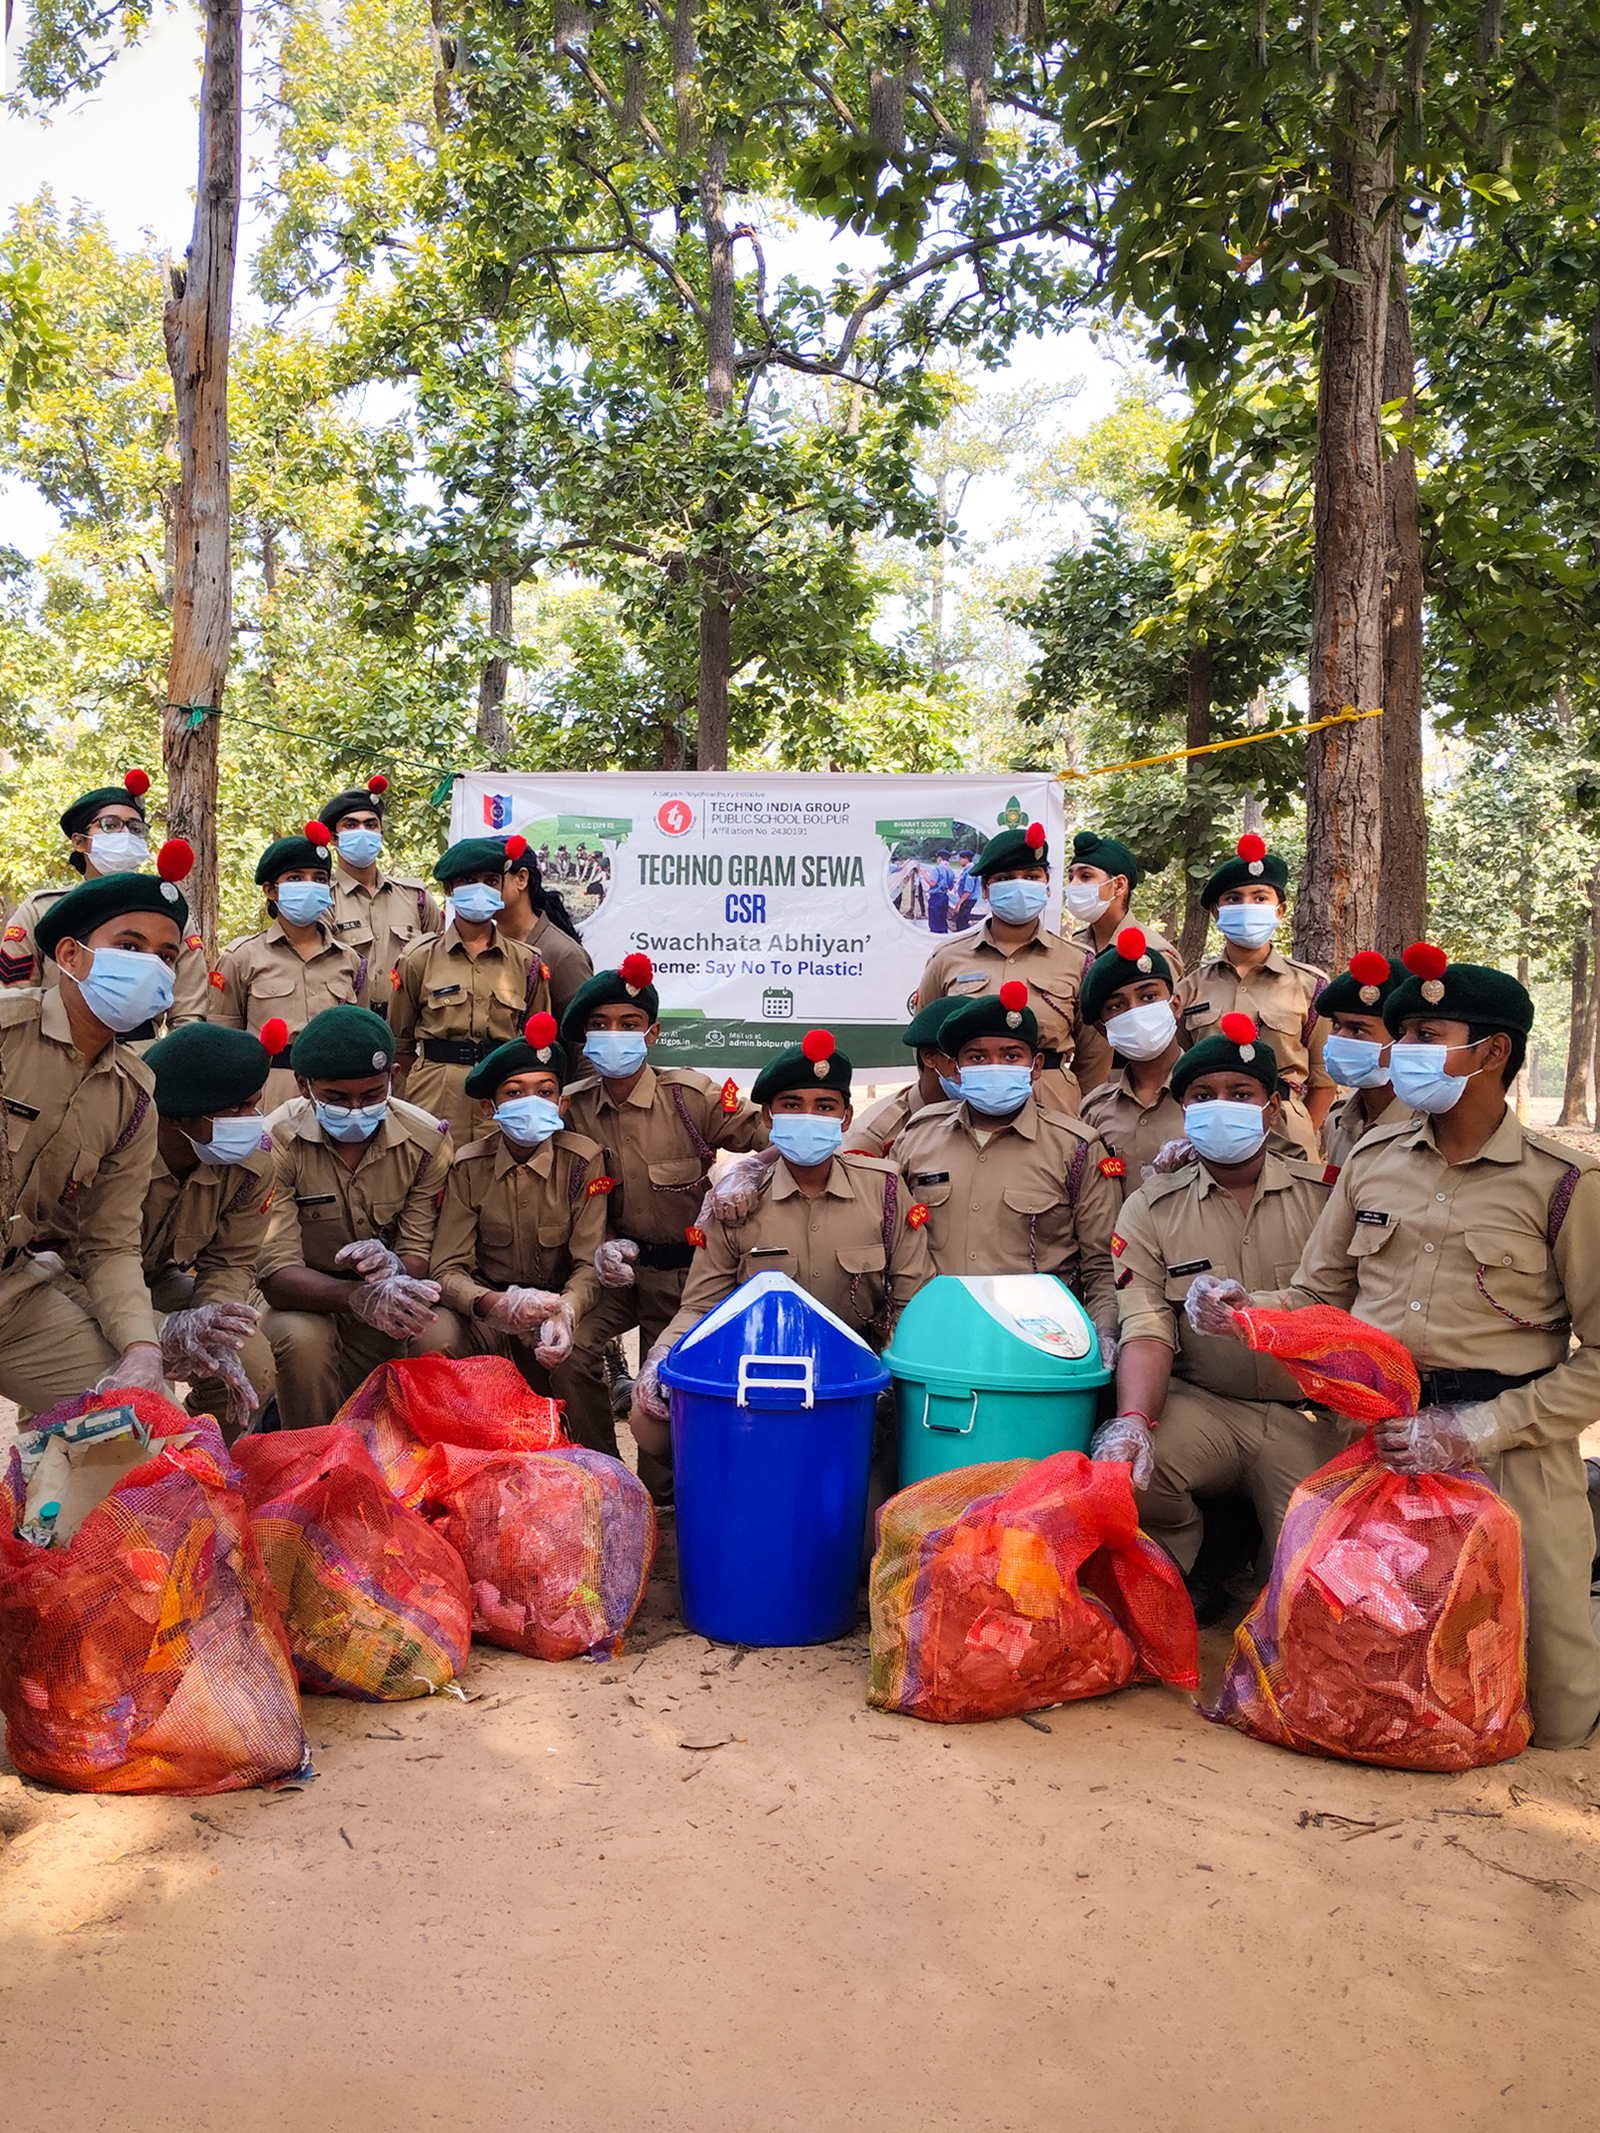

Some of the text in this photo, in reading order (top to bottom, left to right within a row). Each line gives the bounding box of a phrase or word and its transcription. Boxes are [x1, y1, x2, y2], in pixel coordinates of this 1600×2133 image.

[711, 802, 851, 813] TECHNO INDIA GROUP
[711, 814, 850, 825] PUBLIC SCHOOL BOLPUR
[712, 827, 808, 836] Affiliation No. 2430191
[637, 854, 865, 888] TECHNO GRAM SEWA
[725, 893, 767, 924] CSR
[705, 960, 736, 977] Say
[741, 961, 766, 975] No
[770, 961, 792, 976] To
[798, 961, 863, 977] Plastic!
[728, 1039, 803, 1049] admin.bolpur@ti
[725, 1083, 736, 1108] NCC
[1102, 1160, 1121, 1175] NCC
[589, 1180, 610, 1195] NCC
[911, 1206, 927, 1225] NCC
